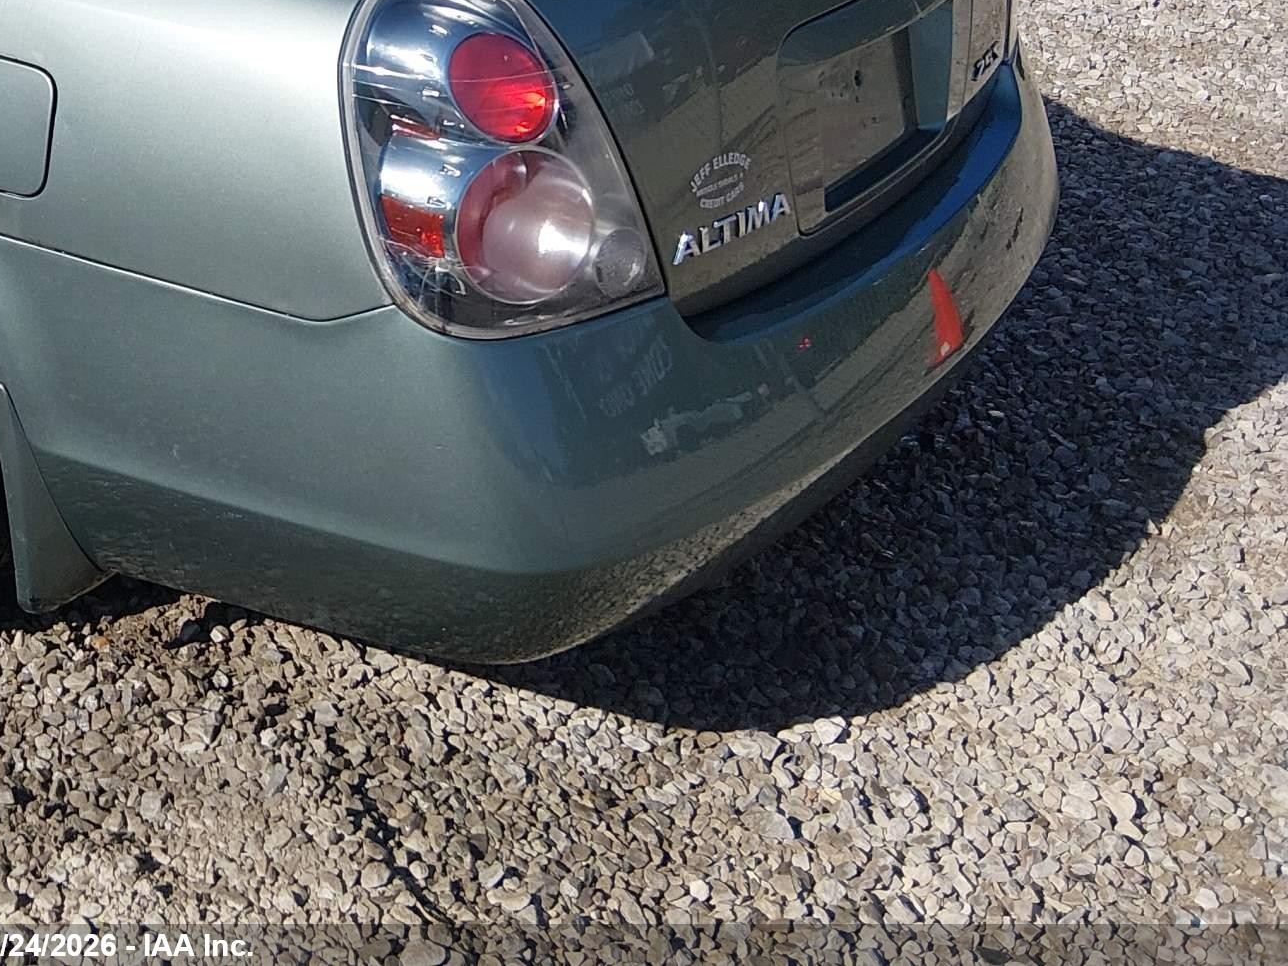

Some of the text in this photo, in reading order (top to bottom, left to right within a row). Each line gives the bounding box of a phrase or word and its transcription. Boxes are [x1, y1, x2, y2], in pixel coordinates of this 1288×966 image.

[690, 152, 751, 193] JEFF ELLEDGE
[699, 195, 725, 210] CREDIT
[671, 192, 791, 266] ALTIMA
